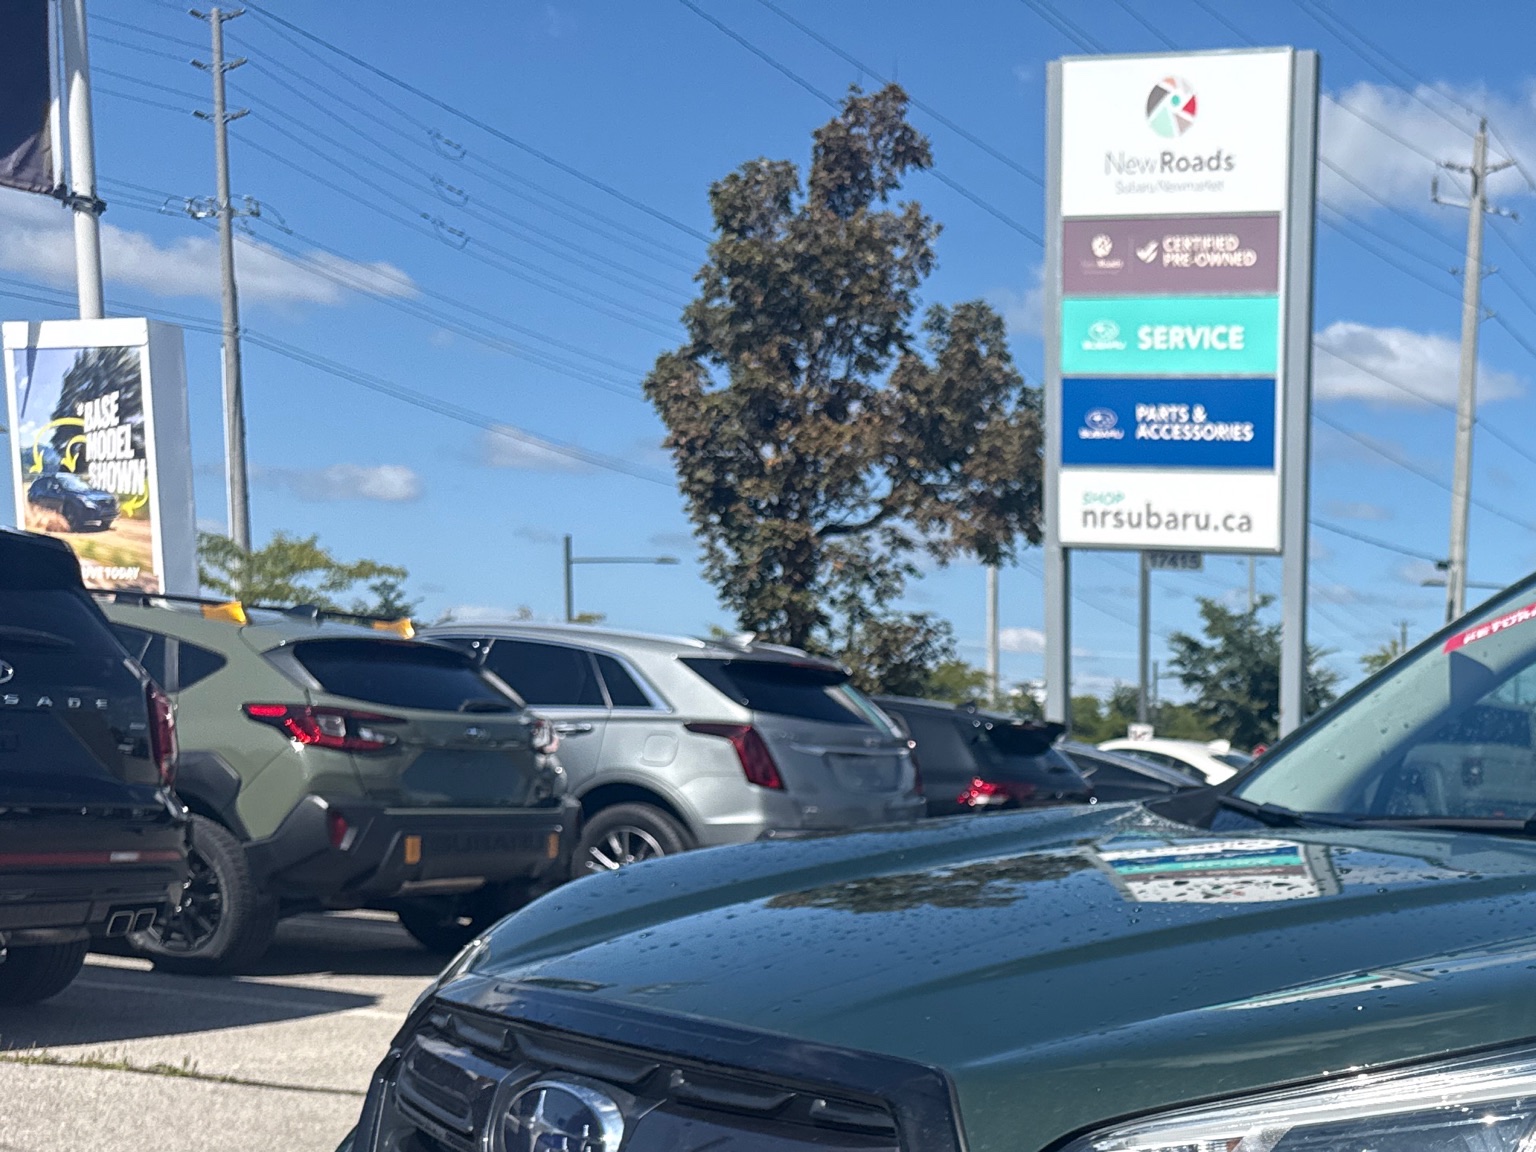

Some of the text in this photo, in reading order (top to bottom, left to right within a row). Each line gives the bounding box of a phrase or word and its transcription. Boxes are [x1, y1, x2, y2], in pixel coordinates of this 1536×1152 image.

[1162, 234, 1239, 252] CERTIFIED
[1162, 249, 1257, 268] PRE-OWNED
[1137, 325, 1245, 350] SERVICE
[1135, 403, 1207, 423] PARTS &
[1135, 421, 1254, 442] ACCESSORIES
[85, 423, 135, 462] MODEL
[88, 458, 146, 496] SHOWN
[1082, 503, 1252, 533] nrsubaru.ca
[104, 566, 140, 580] TODAY
